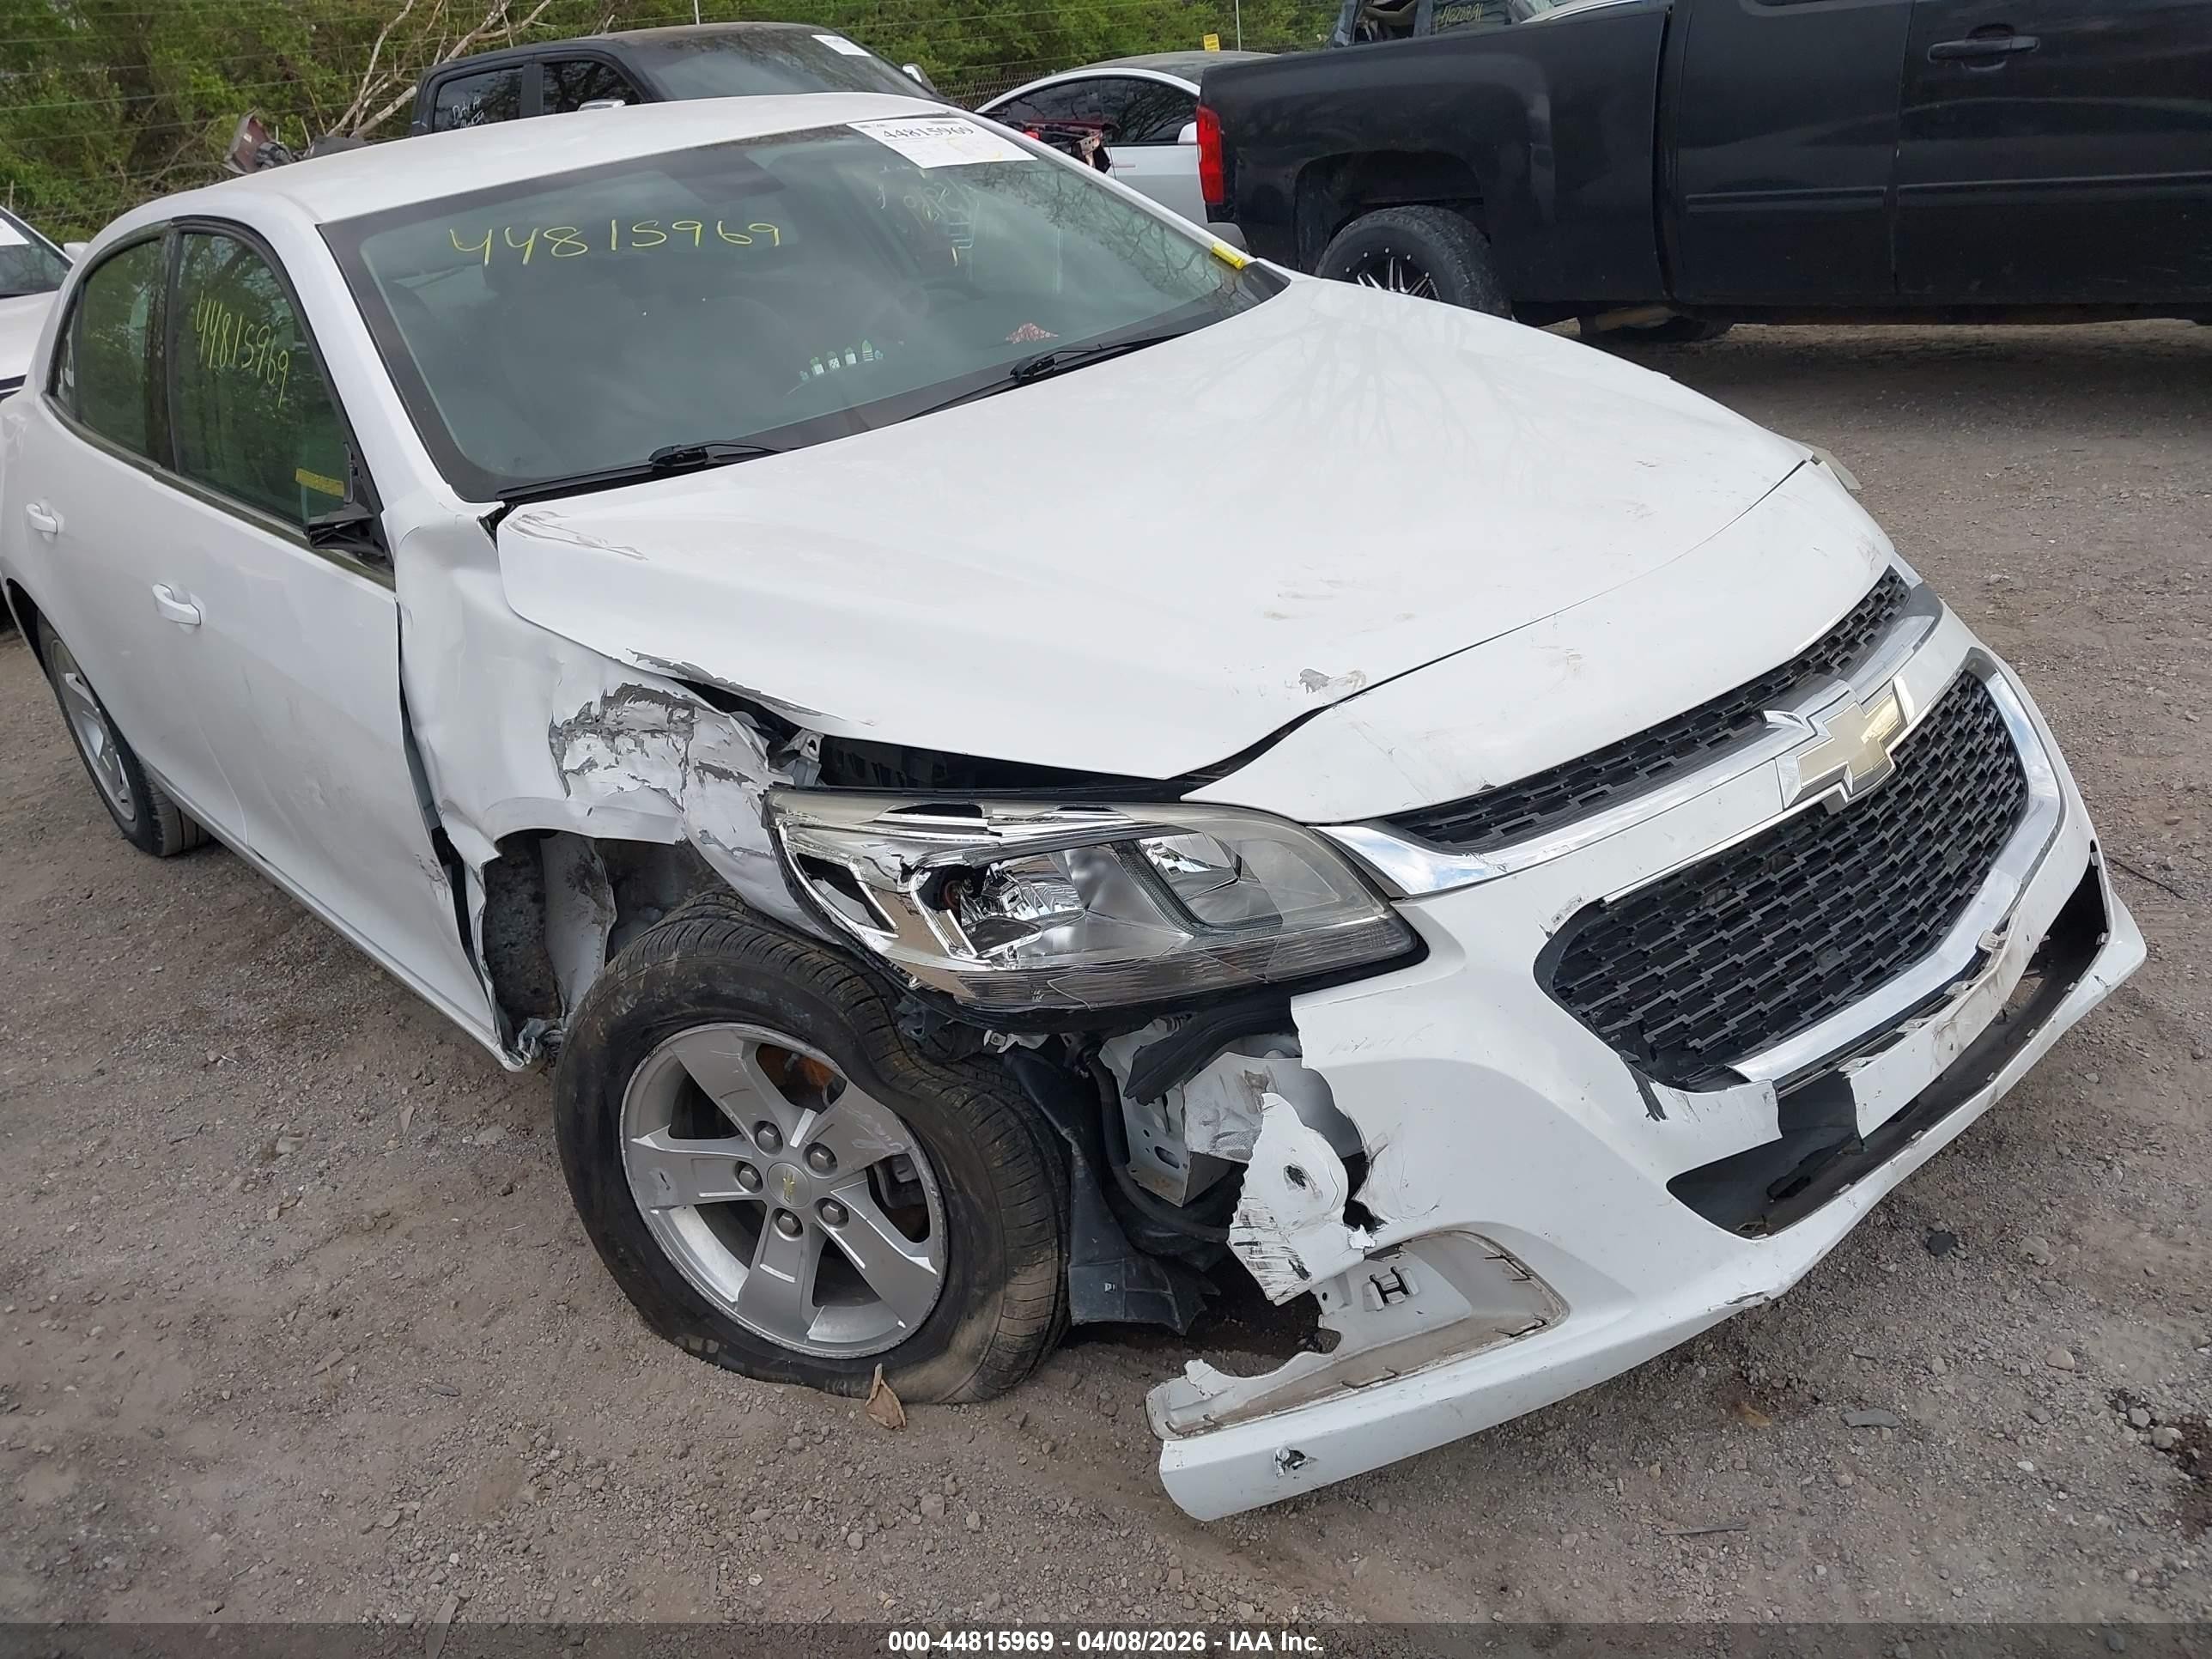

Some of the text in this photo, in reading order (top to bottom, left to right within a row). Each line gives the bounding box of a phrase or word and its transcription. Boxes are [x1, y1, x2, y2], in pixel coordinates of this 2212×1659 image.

[883, 126, 974, 138] 44815969
[449, 219, 781, 266] 44815969
[196, 289, 289, 408] 44815969
